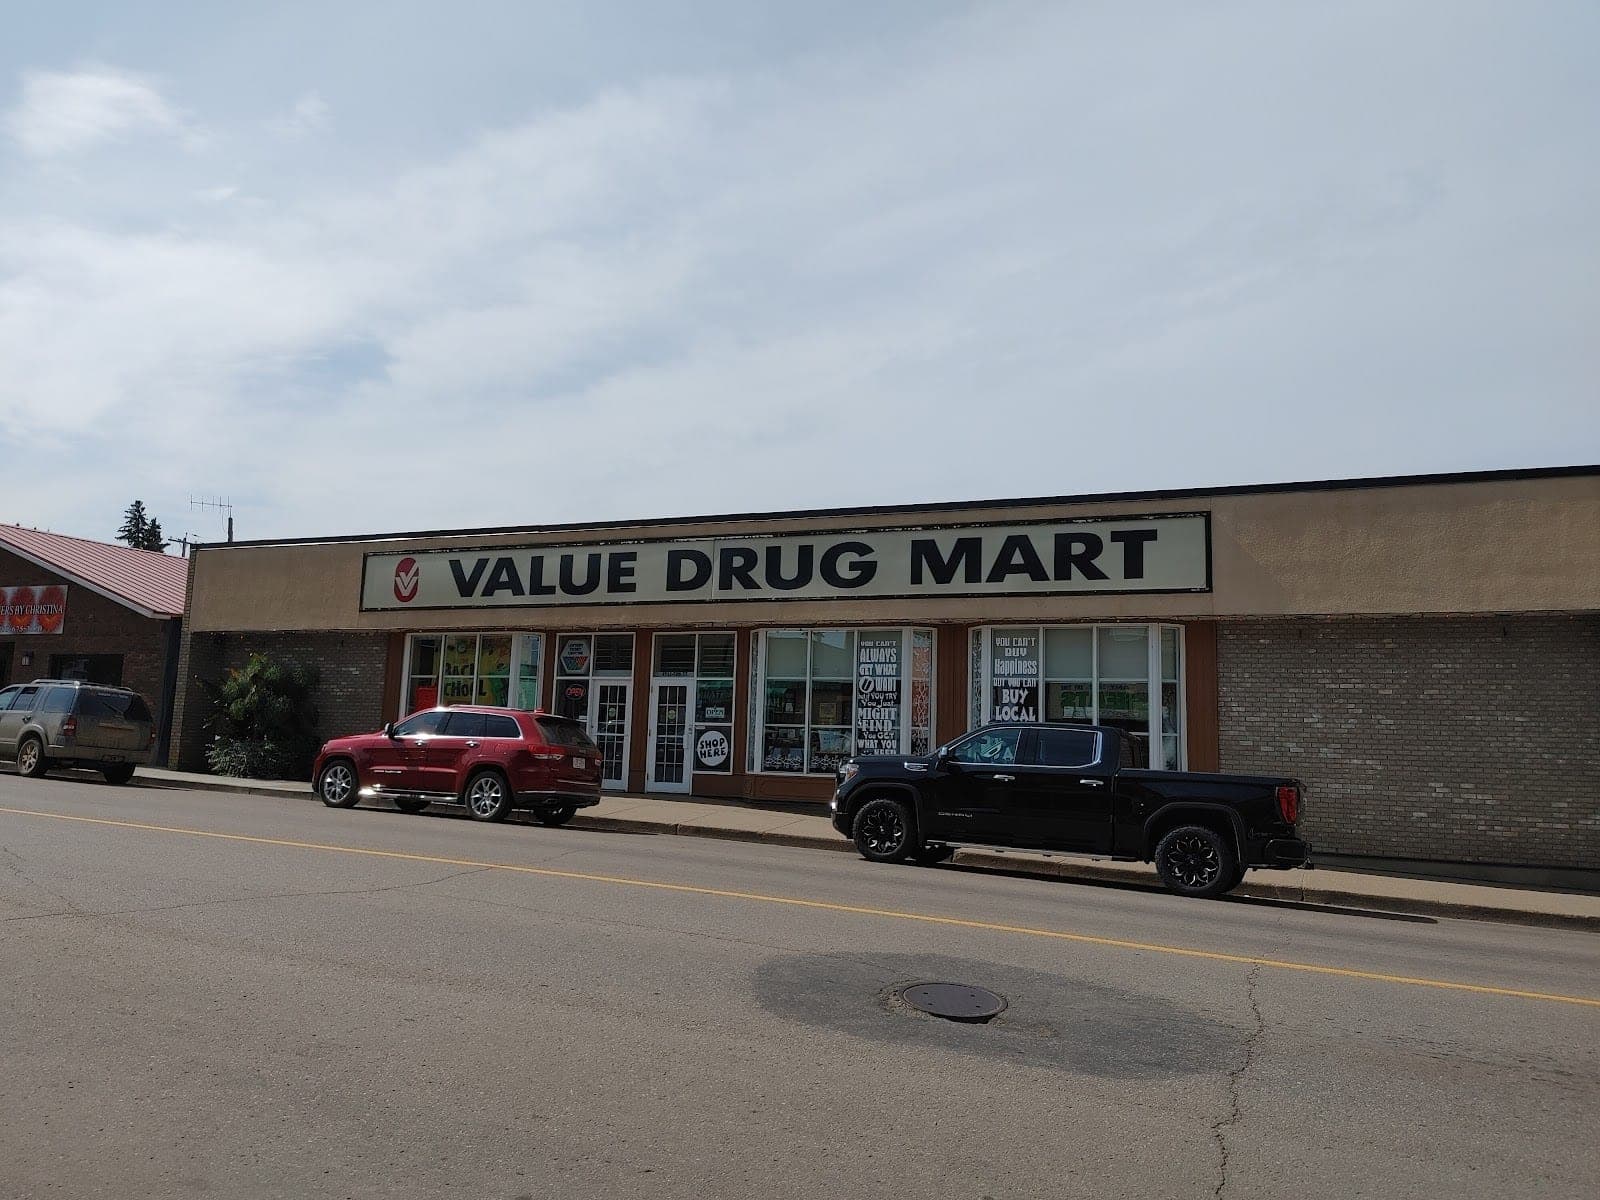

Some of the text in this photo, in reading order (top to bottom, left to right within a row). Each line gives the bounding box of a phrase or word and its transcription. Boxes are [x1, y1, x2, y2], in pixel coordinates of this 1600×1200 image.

[449, 528, 1158, 598] VALUE DRUG MART
[0, 604, 14, 616] ERS
[26, 603, 64, 615] CHRISTINA
[995, 637, 1036, 647] YOU CAN'T
[859, 647, 897, 663] ALWAYS
[1004, 647, 1027, 657] BUY
[859, 663, 897, 676] GET WHAT
[994, 658, 1037, 676] Happiness
[875, 677, 897, 692] WANT
[870, 692, 884, 700] YOU
[885, 692, 898, 700] TRY
[1002, 688, 1029, 704] BUY
[858, 707, 897, 720] MIGHT
[995, 705, 1036, 722] LOCAL
[861, 719, 893, 732] FIND
[700, 737, 725, 749] SHOP
[857, 739, 897, 749] WHAT YOU
[700, 748, 726, 759] HERE
